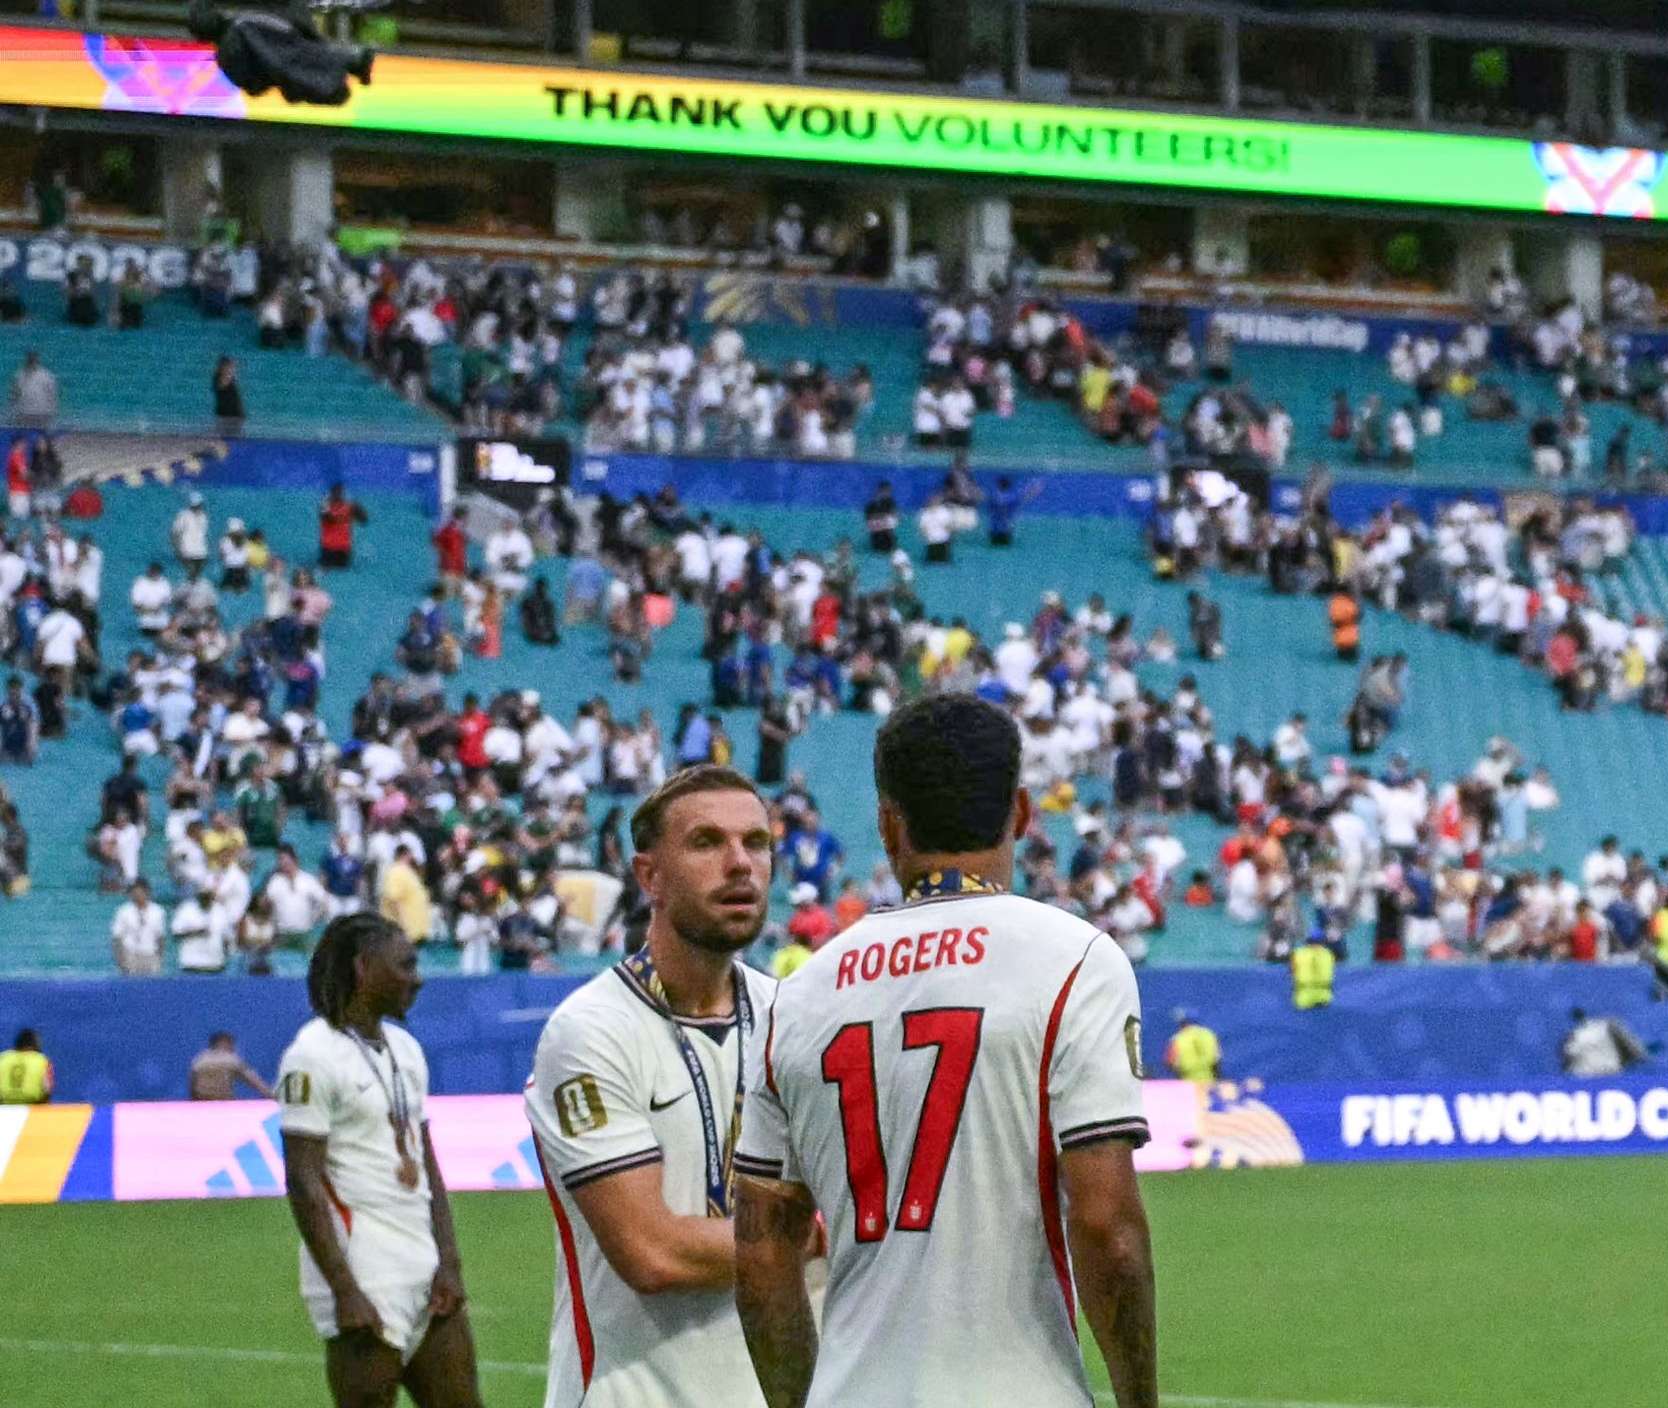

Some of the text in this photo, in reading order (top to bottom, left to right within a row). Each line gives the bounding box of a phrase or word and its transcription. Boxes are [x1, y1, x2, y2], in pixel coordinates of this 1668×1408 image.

[544, 86, 1291, 174] THANK YOU VOLUNTEERS!
[836, 927, 990, 990] ROGERS
[821, 1006, 985, 1243] 17
[1341, 1094, 1456, 1147] FIFA
[1456, 1089, 1636, 1144] WORLD
